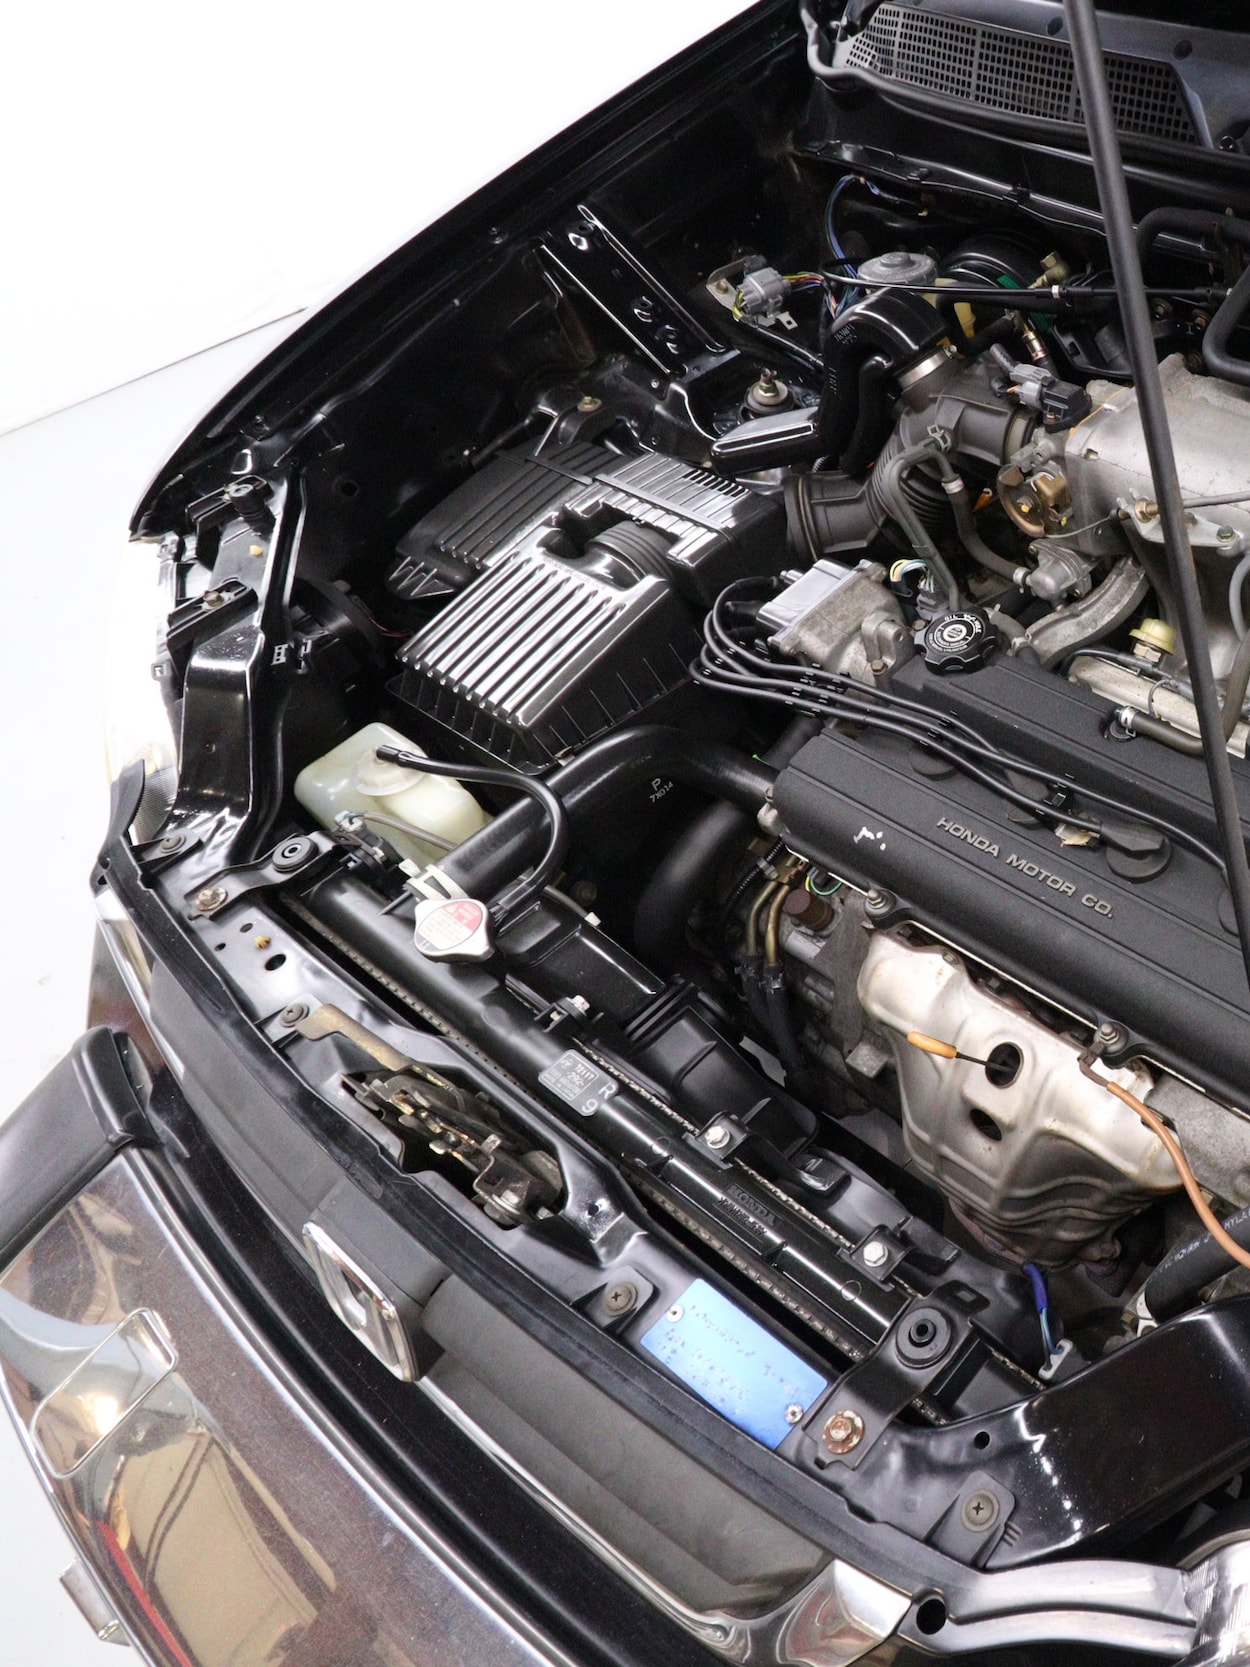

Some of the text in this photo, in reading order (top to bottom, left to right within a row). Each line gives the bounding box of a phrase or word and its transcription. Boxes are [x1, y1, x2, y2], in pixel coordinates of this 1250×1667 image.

[651, 778, 661, 791] P
[937, 817, 1113, 918] HONDA MOTOR CO.
[598, 1082, 616, 1099] R
[582, 1099, 598, 1113] 9
